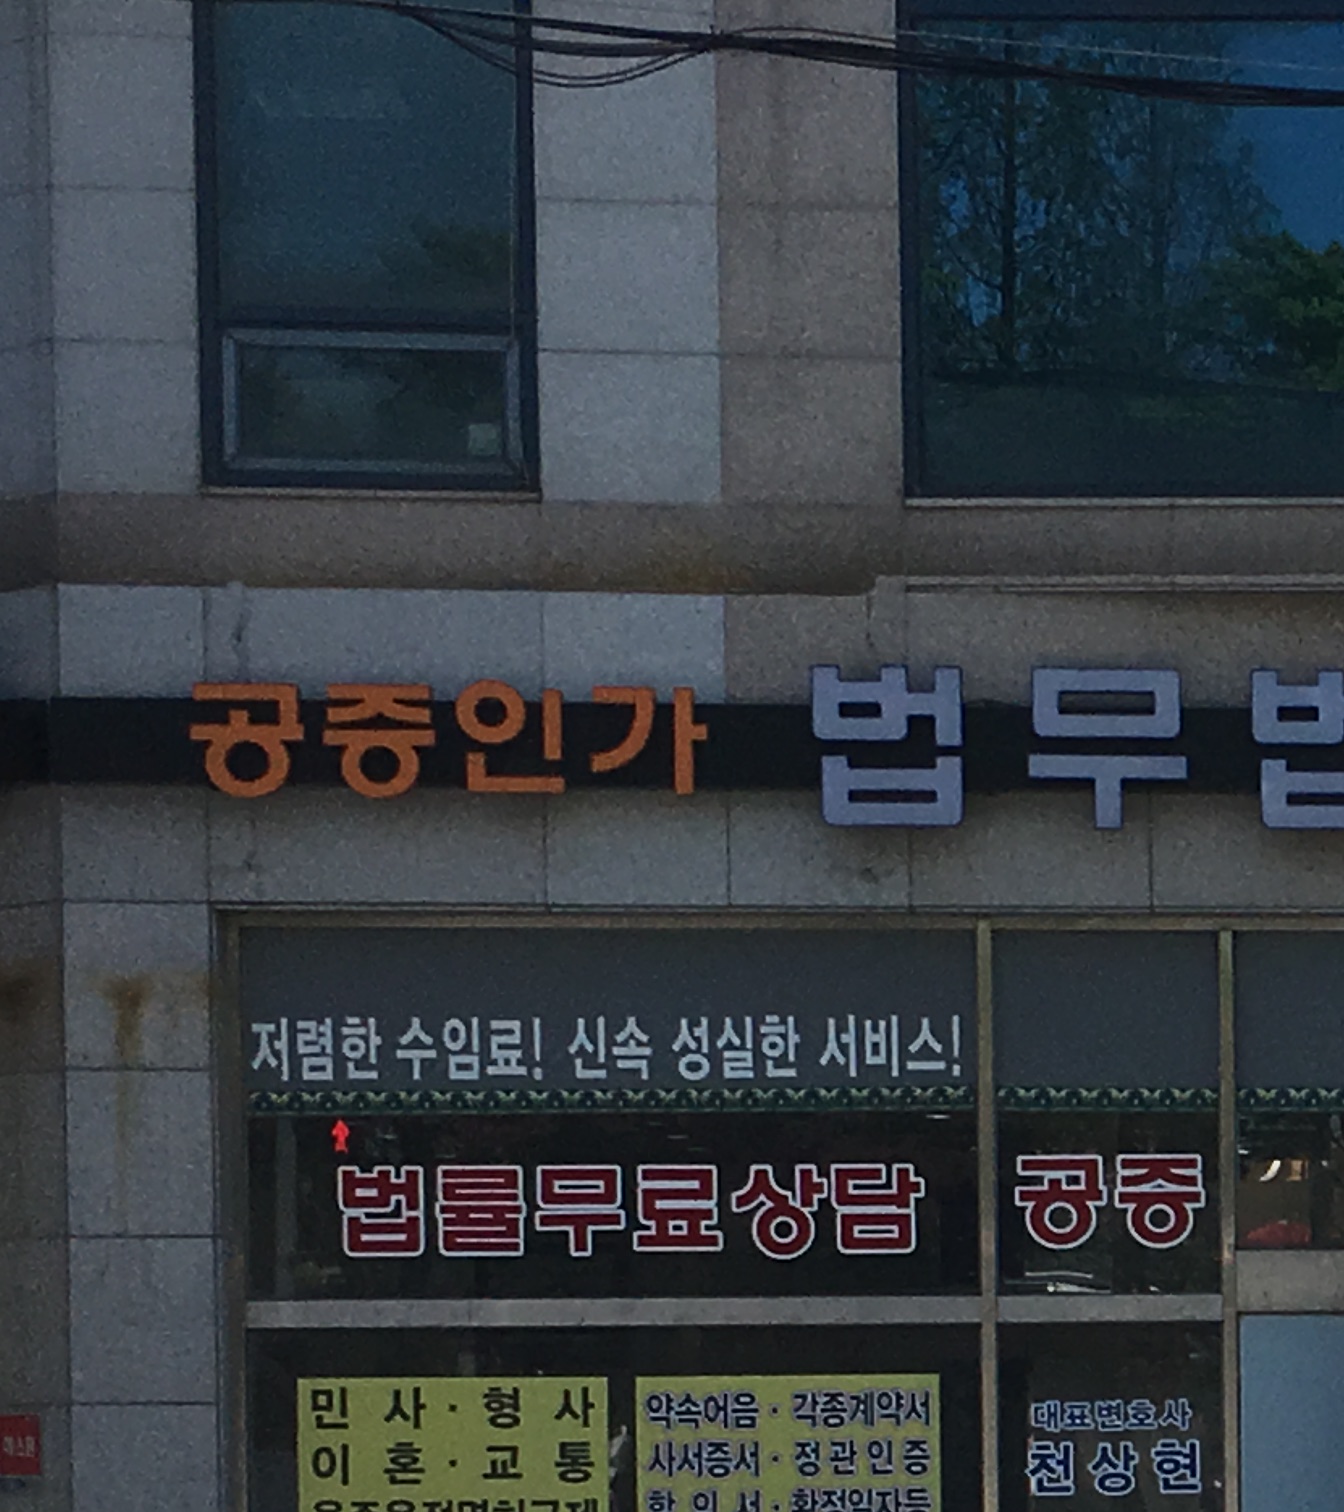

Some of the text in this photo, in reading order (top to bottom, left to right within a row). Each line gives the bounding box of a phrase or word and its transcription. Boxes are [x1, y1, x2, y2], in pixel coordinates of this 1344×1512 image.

[190, 679, 708, 798] 공증인가
[250, 1013, 962, 1081] 저렴한 수임료! 신속 성실한 서비스!
[337, 1162, 925, 1261] 법률무료상담
[1014, 1151, 1206, 1250] 공증
[1030, 1397, 1193, 1433] 대표변호사
[1025, 1437, 1202, 1497] 천상현
